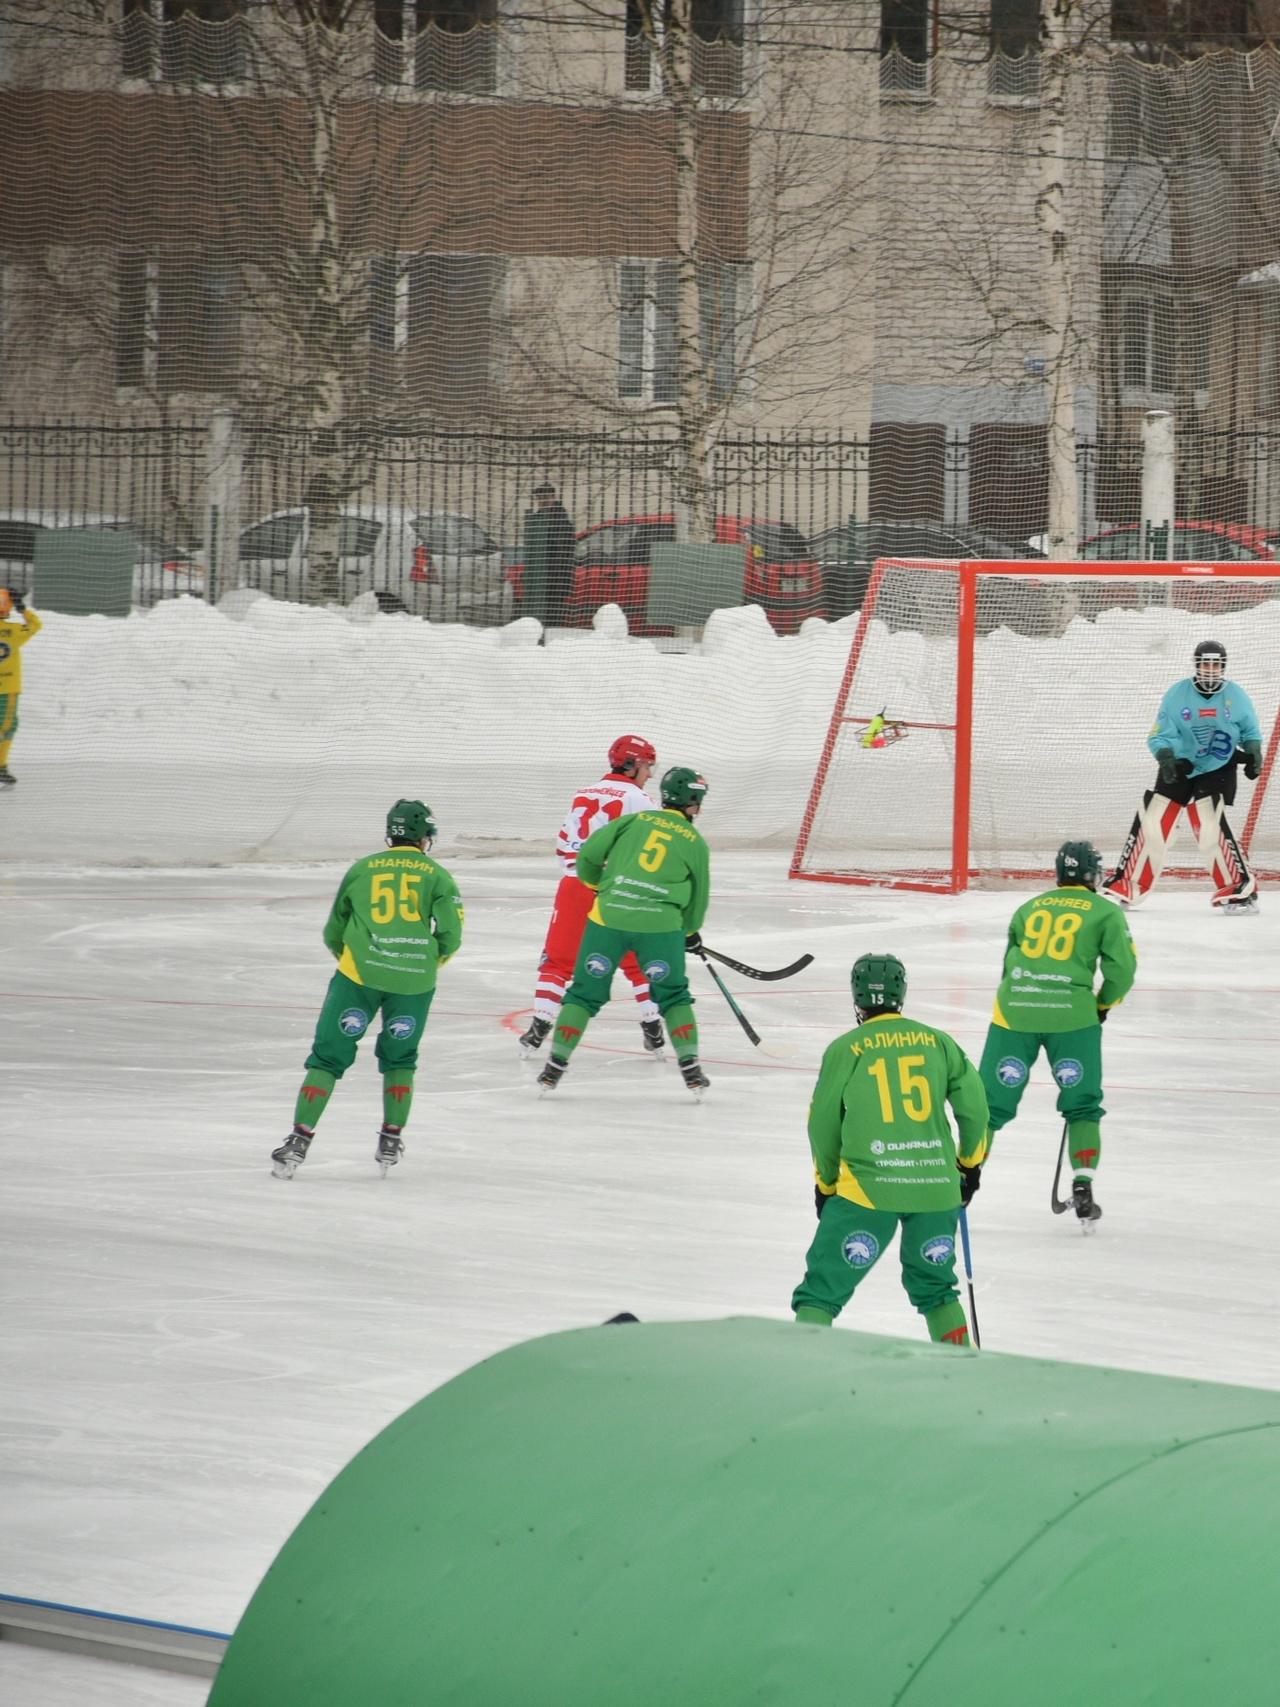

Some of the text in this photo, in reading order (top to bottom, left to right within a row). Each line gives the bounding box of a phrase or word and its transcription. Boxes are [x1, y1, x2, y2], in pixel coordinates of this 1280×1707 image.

[391, 825, 405, 836] 55
[571, 796, 624, 840] 71
[368, 858, 434, 875] АНАНЬИН
[638, 829, 673, 873] 5
[370, 872, 422, 924] 55
[1031, 896, 1093, 912] КОНЯЕВ
[1020, 909, 1083, 961] 98
[871, 994, 885, 1005] 15
[850, 1032, 937, 1057] КАЛИНИН
[867, 1054, 934, 1124] 15
